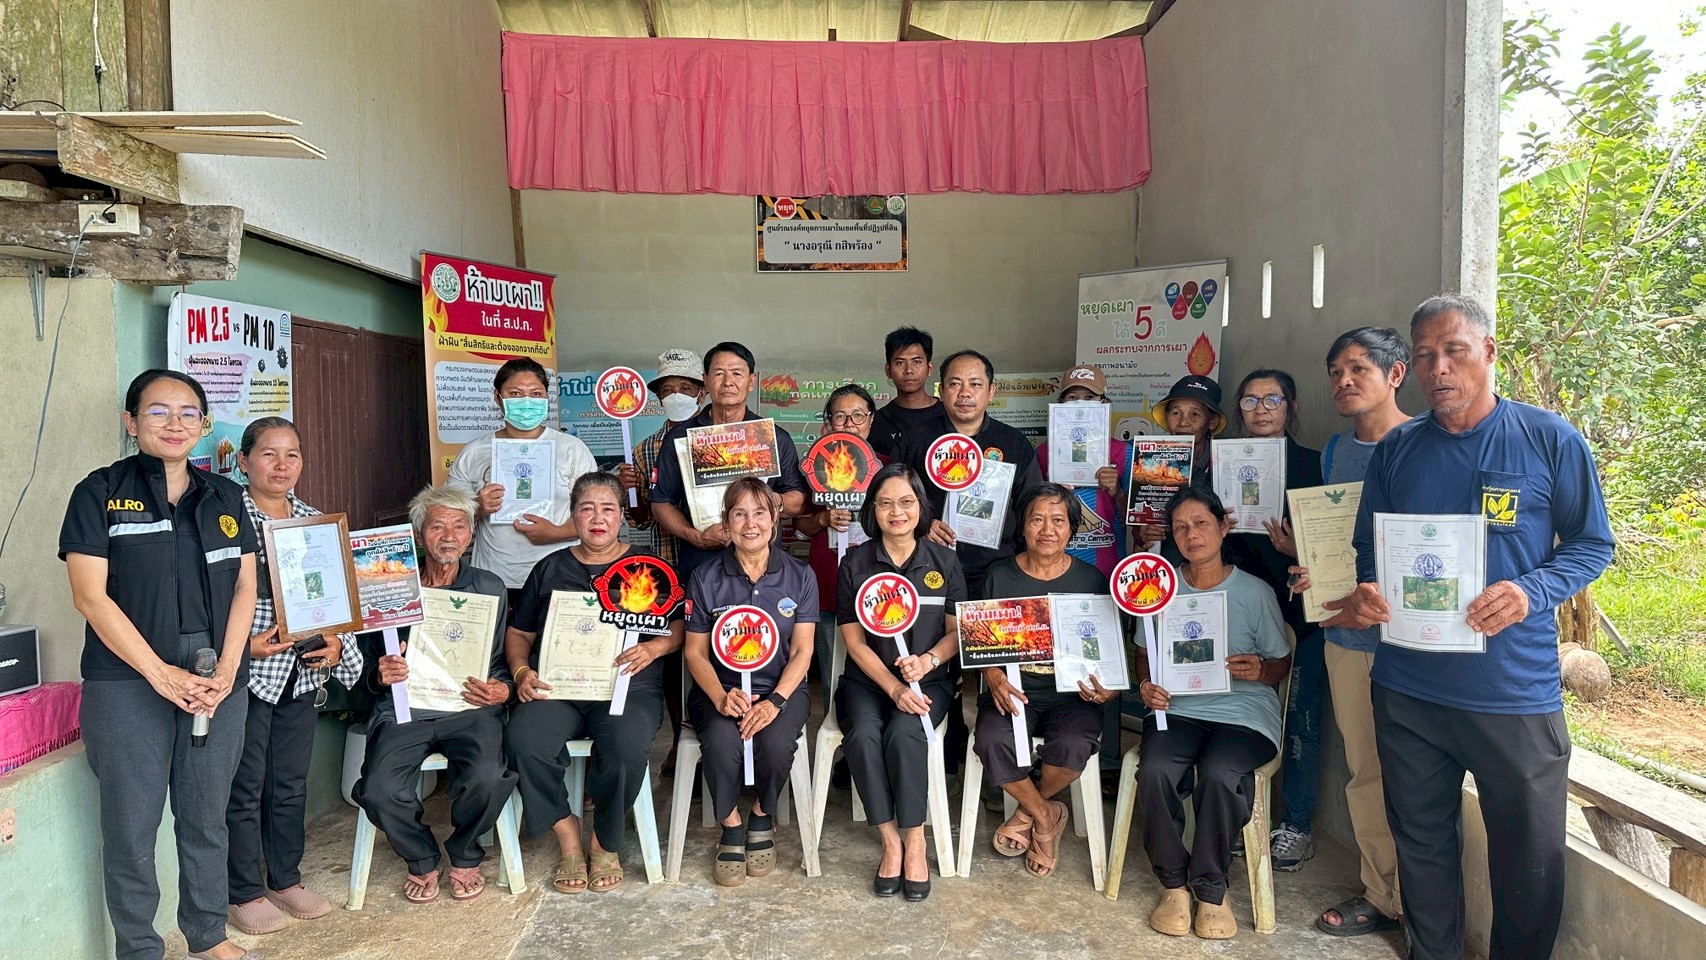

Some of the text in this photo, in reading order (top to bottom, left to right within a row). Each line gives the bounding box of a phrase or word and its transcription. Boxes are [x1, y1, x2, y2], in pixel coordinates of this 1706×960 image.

[777, 202, 794, 215] หยุด
[793, 240, 832, 253] นางอรุณี
[835, 239, 873, 251] กสิพร้อง
[466, 267, 544, 308] ห้ามเผา!!
[1080, 300, 1134, 320] หยุดเผา
[481, 309, 533, 331] ในที่ ส.ป.ก.
[1113, 305, 1167, 340] ได้ 5 ดี
[187, 307, 208, 345] PM
[211, 305, 230, 342] 2.5
[243, 312, 260, 349] PM
[262, 319, 275, 351] 10
[438, 335, 459, 347] ฝ่าฝืน
[1096, 342, 1187, 355] ผลกระทบจากการเผา
[219, 357, 227, 366] 2.5
[602, 381, 639, 394] ห้ามเผา
[696, 429, 746, 446] ห้ามเผา!
[933, 447, 975, 461] ห้ามเผา
[1139, 442, 1156, 452] เผา
[107, 498, 145, 512] ALRO
[814, 492, 867, 506] หยุดเผา
[1087, 534, 1115, 543] Camping
[1118, 569, 1167, 586] ห้ามเผา
[862, 586, 908, 611] ห้ามเผา
[601, 610, 666, 628] หยุดเผา
[963, 605, 1023, 622] ห้ามเผา!
[720, 622, 769, 639] ห้ามเผา
